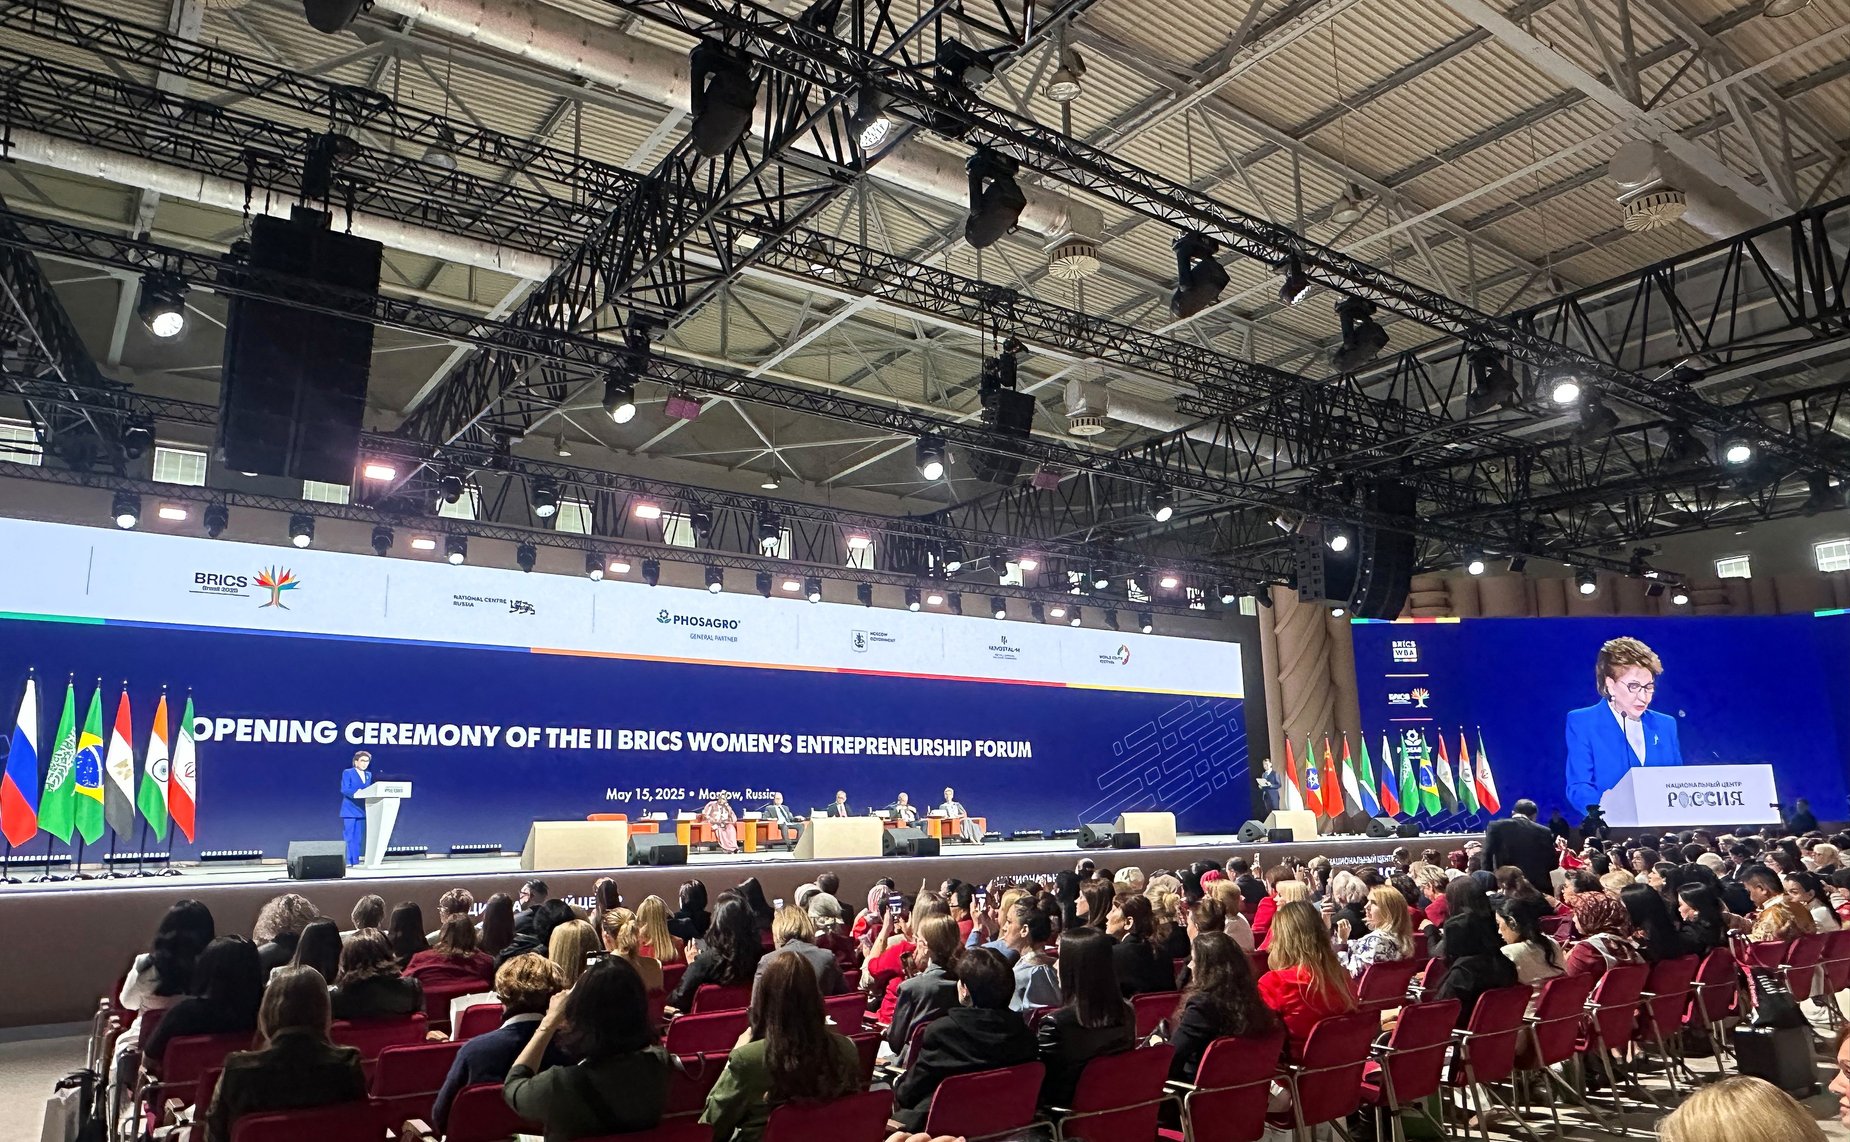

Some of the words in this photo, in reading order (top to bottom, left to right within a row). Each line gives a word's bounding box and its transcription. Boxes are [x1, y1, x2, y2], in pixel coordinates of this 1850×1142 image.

[194, 572, 248, 588] BRICS
[673, 615, 738, 630] PHOSAGRO
[192, 717, 338, 745] OPENING
[344, 721, 502, 748] CEREMONY
[505, 726, 542, 748] OF
[545, 727, 592, 750] THE
[597, 730, 612, 750] II
[617, 730, 683, 752] BRICS
[796, 736, 972, 758] ENTREPRENEURSHIP
[975, 740, 1033, 758] FORUM
[1665, 781, 1721, 789] НАЦИОНАЛЬНЫЙ
[606, 788, 632, 803] May
[635, 788, 654, 803] 15,
[655, 788, 686, 801] 2025
